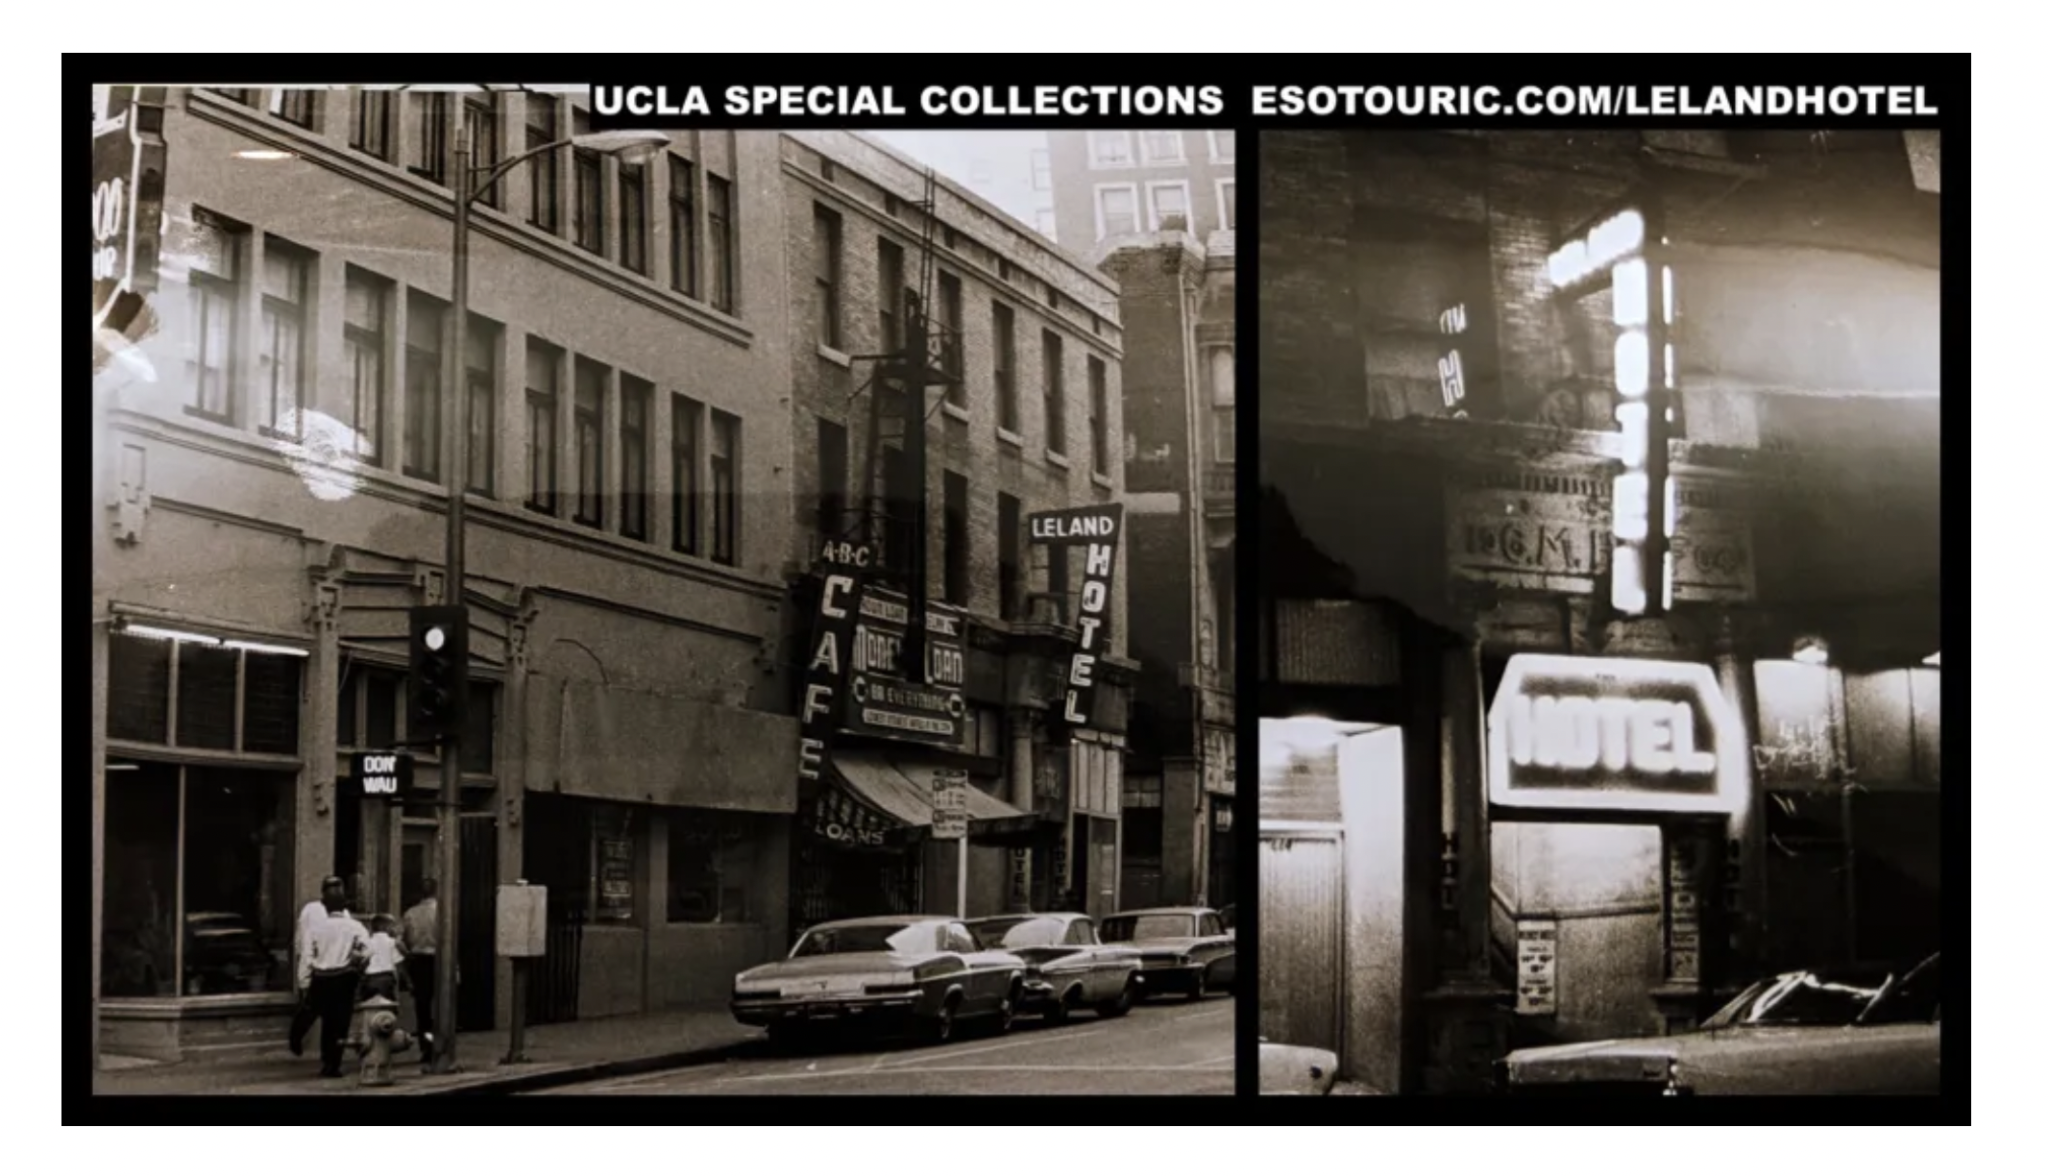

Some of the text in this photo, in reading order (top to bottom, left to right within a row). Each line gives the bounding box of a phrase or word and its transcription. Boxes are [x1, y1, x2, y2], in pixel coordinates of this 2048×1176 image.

[1032, 516, 1114, 537] LELAND
[852, 624, 902, 671] MONE
[1064, 543, 1111, 723] HOTEL
[799, 574, 853, 780] CAFE
[1507, 695, 1717, 773] HOTEL
[814, 823, 885, 847] LOANS
